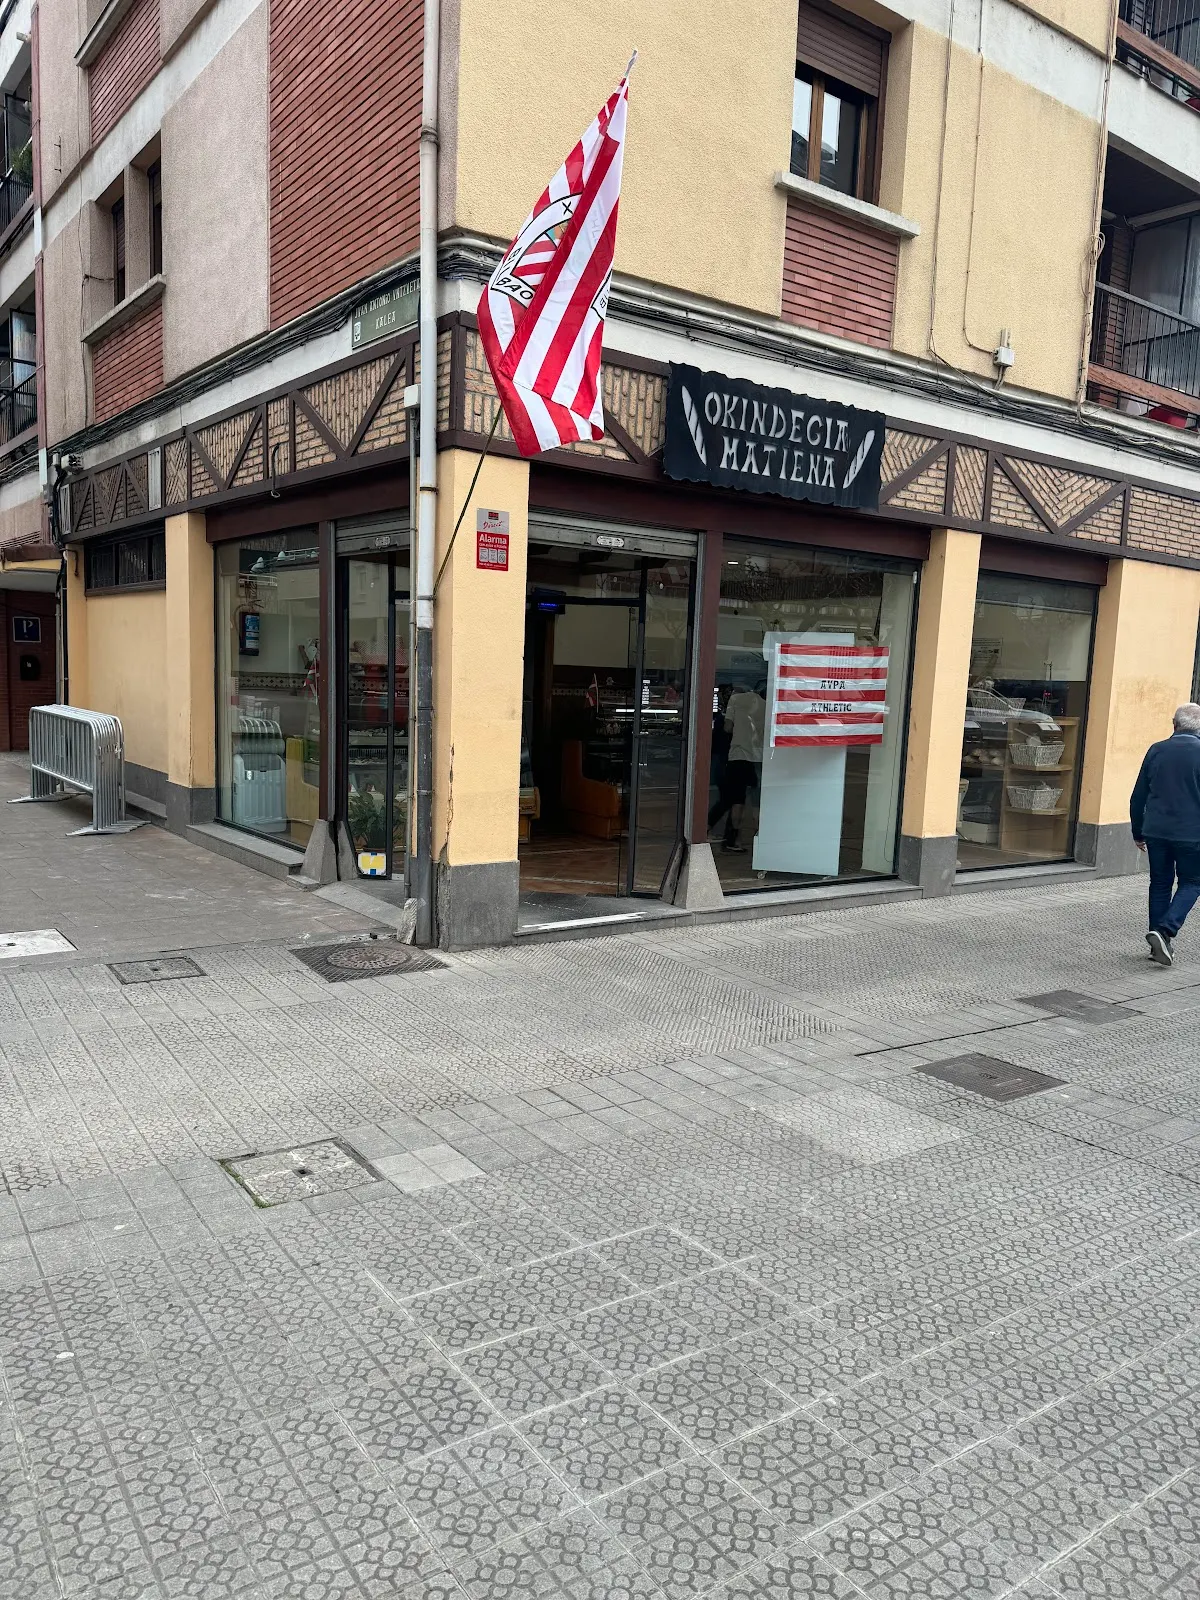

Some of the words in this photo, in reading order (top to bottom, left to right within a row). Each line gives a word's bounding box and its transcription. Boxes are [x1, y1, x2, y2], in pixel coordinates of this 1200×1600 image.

[375, 311, 396, 330] KALEA
[704, 391, 849, 453] OKINDEGIA
[719, 435, 836, 488] MATIENA
[479, 533, 507, 545] Alarma
